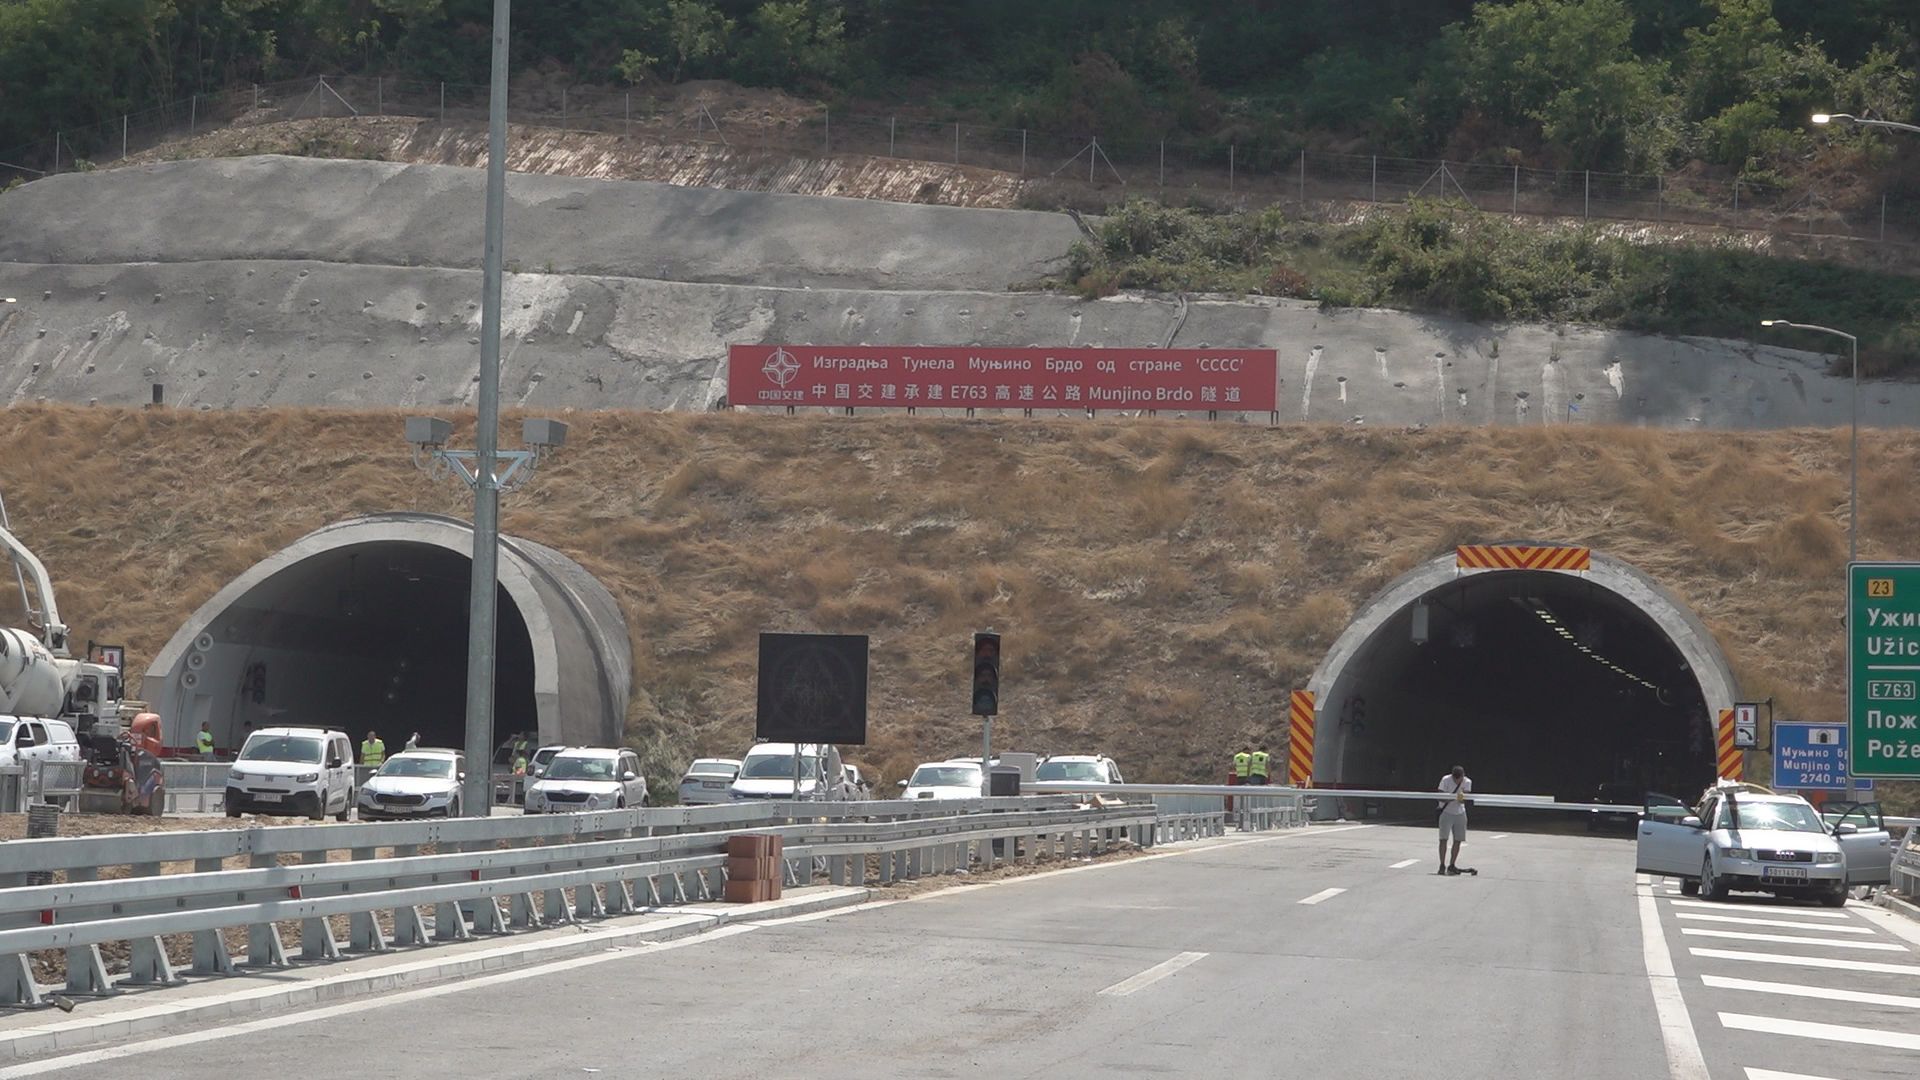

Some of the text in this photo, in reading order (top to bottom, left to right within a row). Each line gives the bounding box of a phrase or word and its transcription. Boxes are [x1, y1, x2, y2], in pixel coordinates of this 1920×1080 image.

[813, 355, 888, 372] Изградња
[902, 356, 955, 372] Тунела
[968, 357, 1032, 373] Муњино
[1045, 357, 1083, 373] Брдо
[1096, 359, 1116, 373] од
[1129, 359, 1182, 373] стране
[951, 385, 988, 400] E763
[1089, 387, 1152, 404] Munjino
[1156, 387, 1193, 402] Brdo
[1872, 580, 1890, 595] 23
[1867, 710, 1918, 729] Пож
[1782, 746, 1829, 759] Муњино
[1867, 739, 1920, 758] Pože
[1783, 760, 1831, 772] Munjino
[1800, 773, 1846, 784] 2740 m
